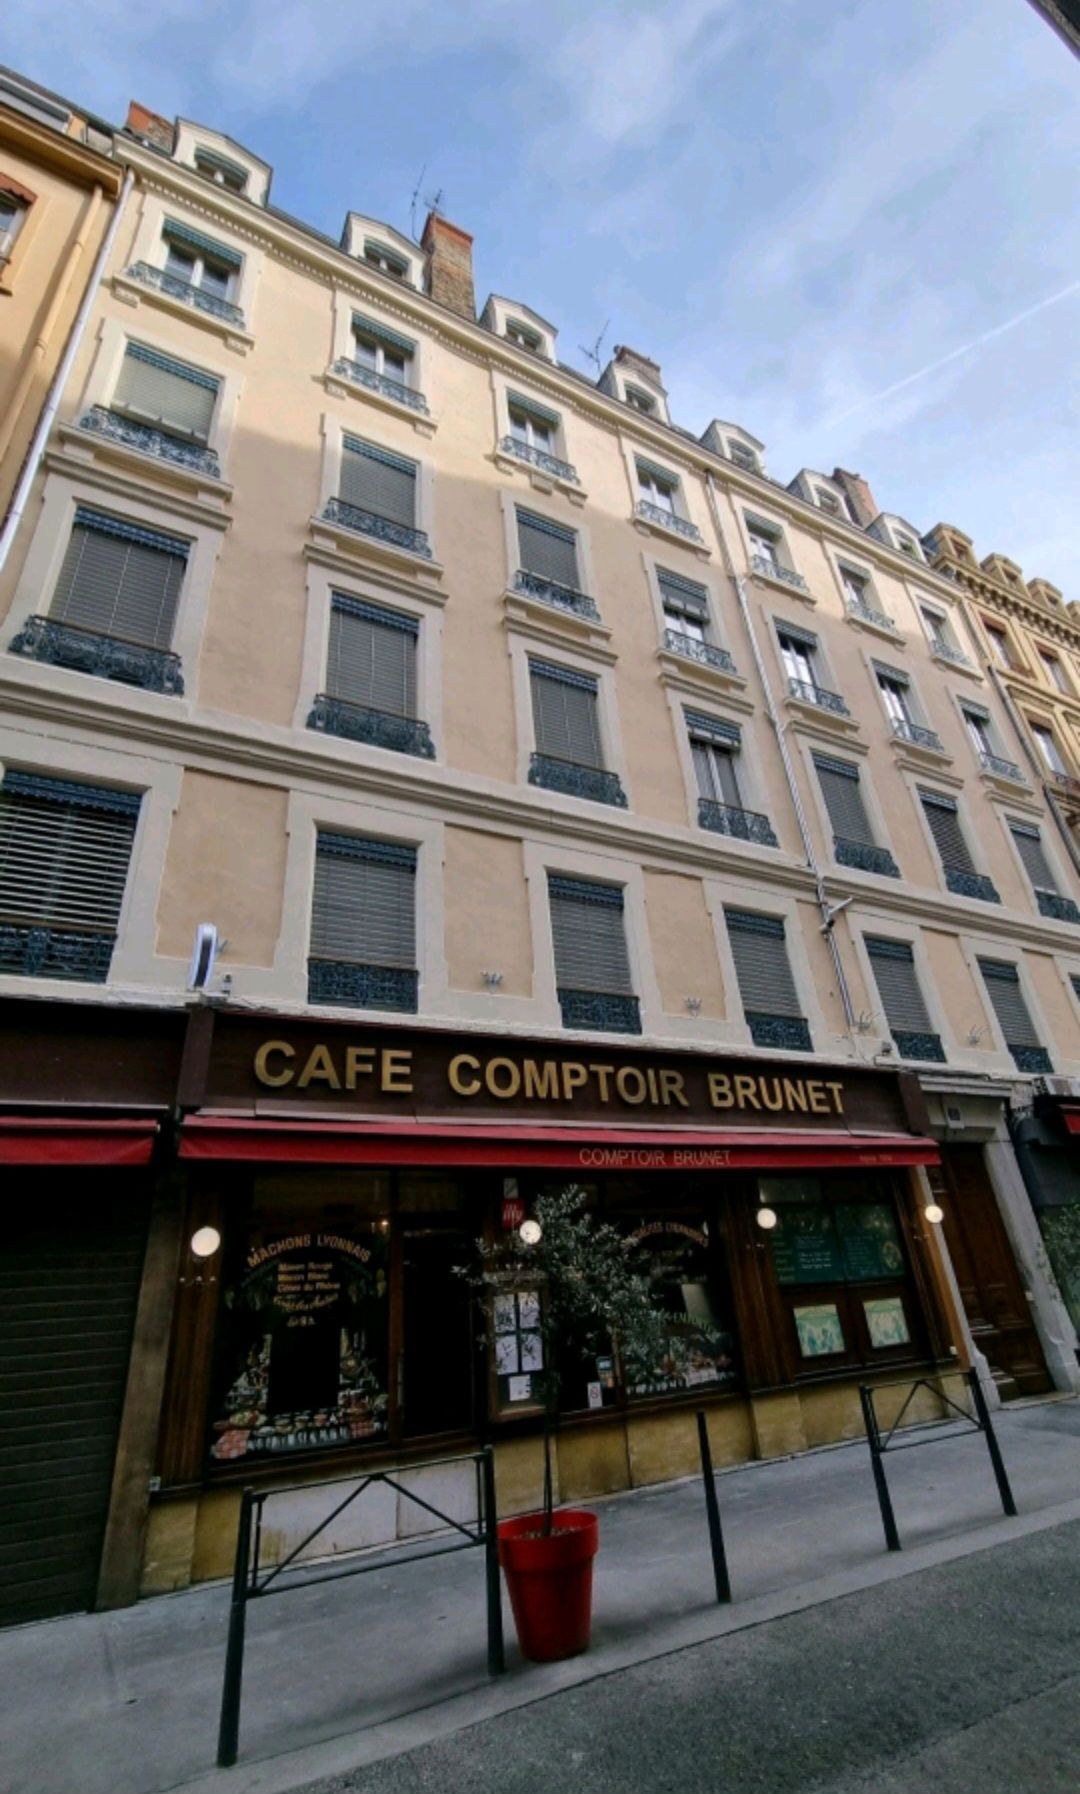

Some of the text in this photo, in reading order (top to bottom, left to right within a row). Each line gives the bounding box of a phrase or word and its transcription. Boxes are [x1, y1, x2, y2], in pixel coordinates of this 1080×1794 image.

[253, 1039, 845, 1115] CAFE COMPTOIR BRUNET
[578, 1148, 732, 1167] COMPTOIR BRUNET
[316, 1232, 372, 1263] LYONNAIS
